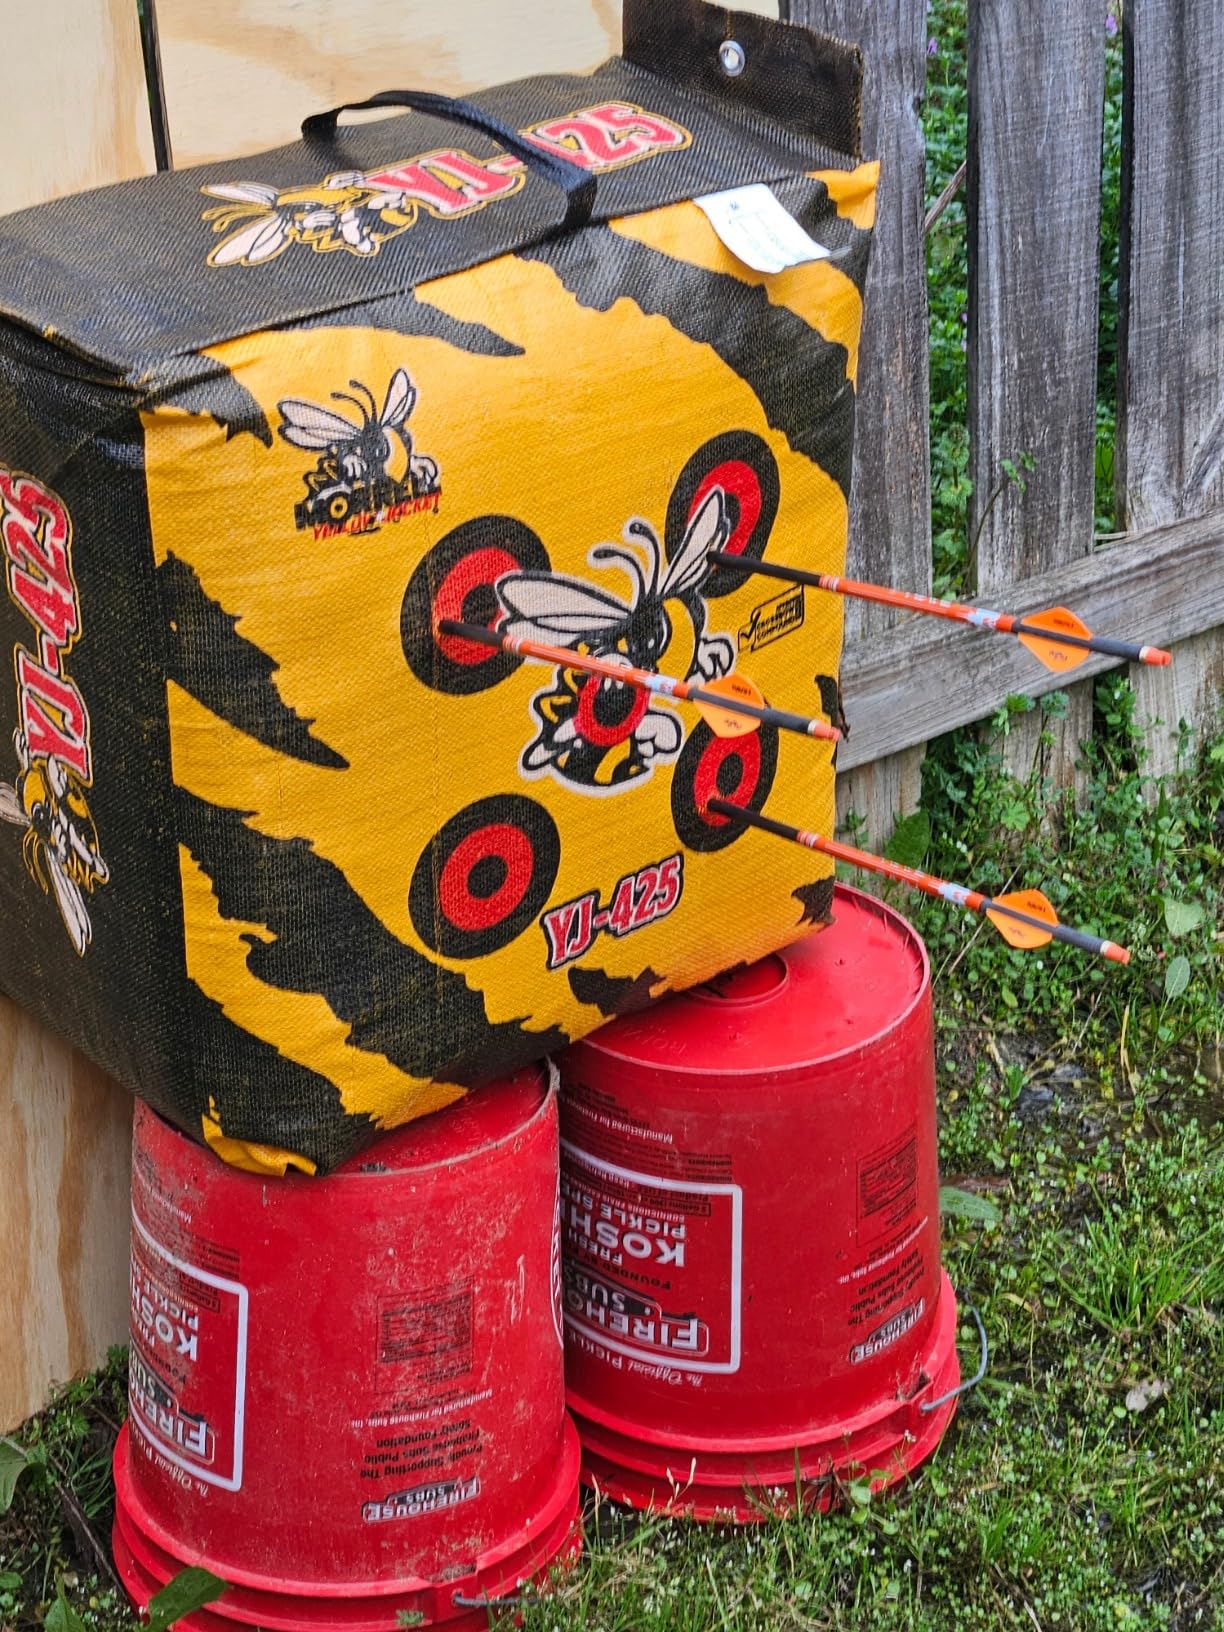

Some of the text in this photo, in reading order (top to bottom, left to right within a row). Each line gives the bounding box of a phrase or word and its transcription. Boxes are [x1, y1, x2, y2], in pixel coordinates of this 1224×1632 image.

[543, 854, 682, 969] YJ-425
[600, 1202, 686, 1239] PICKLE
[569, 1227, 622, 1266] FRESH
[144, 1278, 199, 1332] PICKLE
[850, 1294, 875, 1312] Public
[847, 1315, 863, 1326] The
[852, 1298, 923, 1363] FIREHOUSE
[627, 1360, 683, 1385] Official
[375, 1430, 437, 1449] Foundation
[363, 1452, 399, 1464] Public
[383, 1456, 444, 1478] Supporting
[359, 1468, 380, 1480] The
[366, 1478, 478, 1521] FIREHOUSE
[405, 1484, 447, 1505] SUBS
